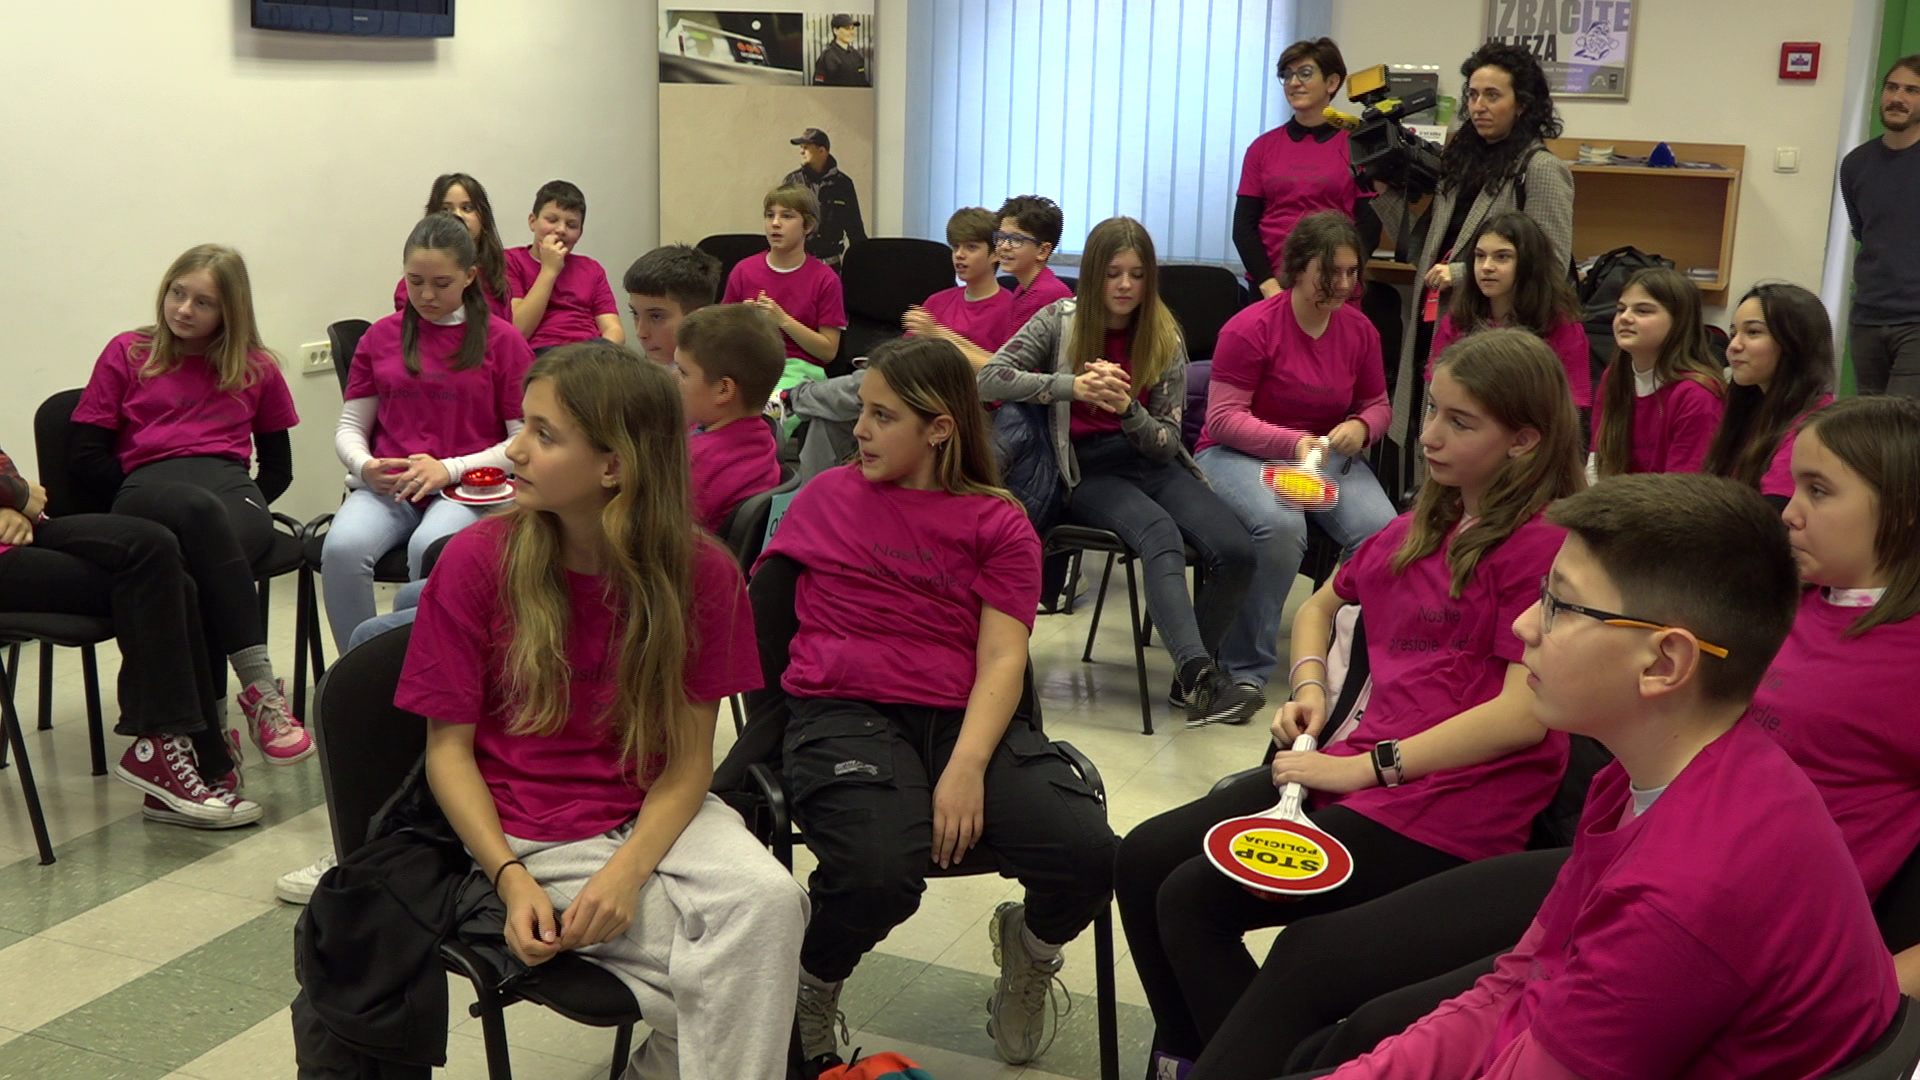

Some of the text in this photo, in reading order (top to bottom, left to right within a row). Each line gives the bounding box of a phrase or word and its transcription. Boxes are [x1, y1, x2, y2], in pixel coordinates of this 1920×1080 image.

[1487, 0, 1630, 36] IZBACITE
[1244, 835, 1318, 856] POLICIJA
[1235, 848, 1320, 872] STOP
